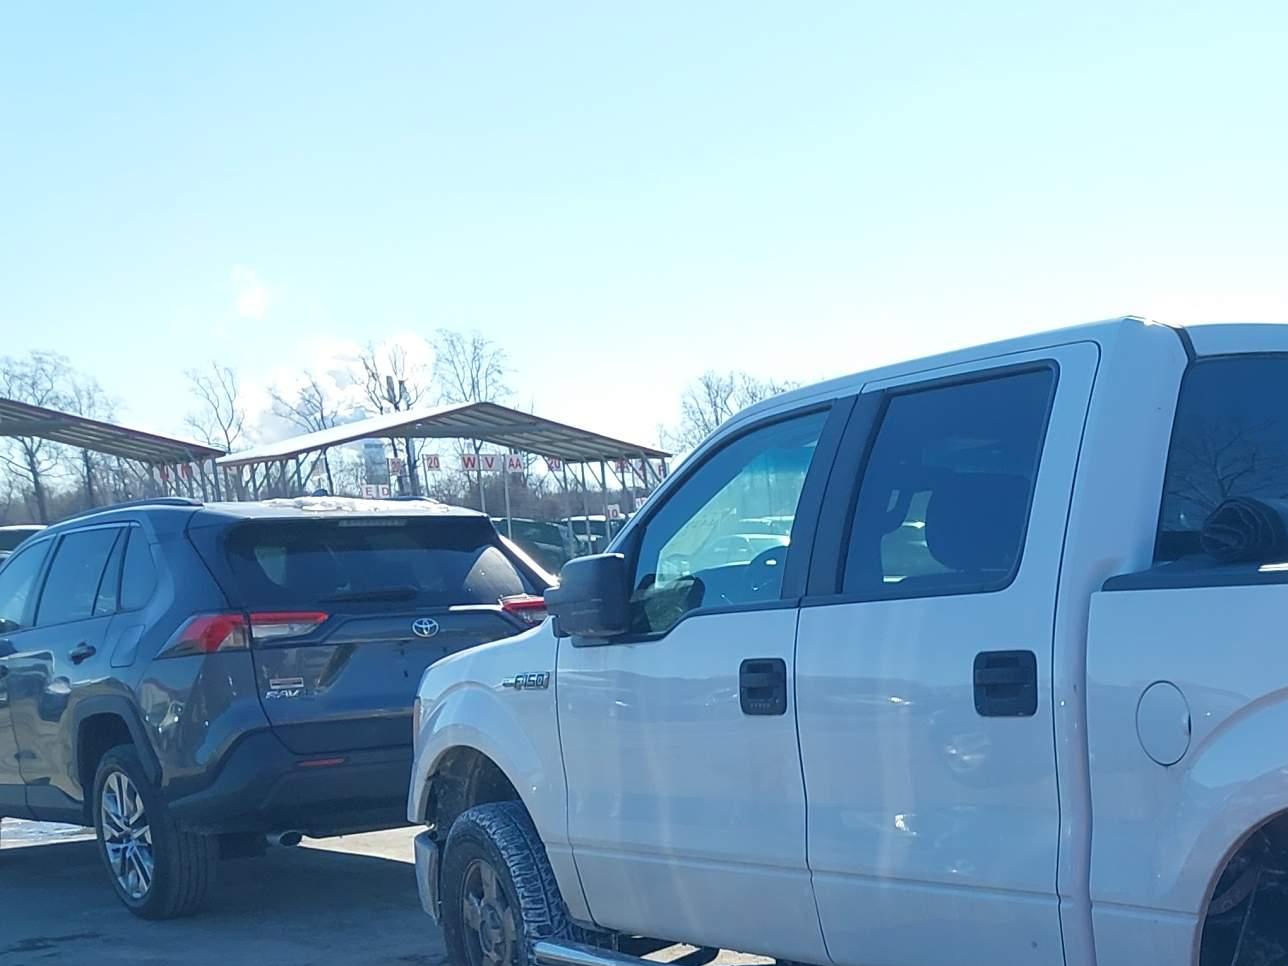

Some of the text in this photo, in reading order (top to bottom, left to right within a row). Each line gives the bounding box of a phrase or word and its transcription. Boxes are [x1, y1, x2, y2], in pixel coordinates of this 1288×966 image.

[427, 456, 440, 469] 20
[463, 456, 477, 469] W
[484, 456, 495, 469] V
[508, 457, 522, 470] AA
[365, 487, 374, 497] E
[381, 487, 390, 496] D
